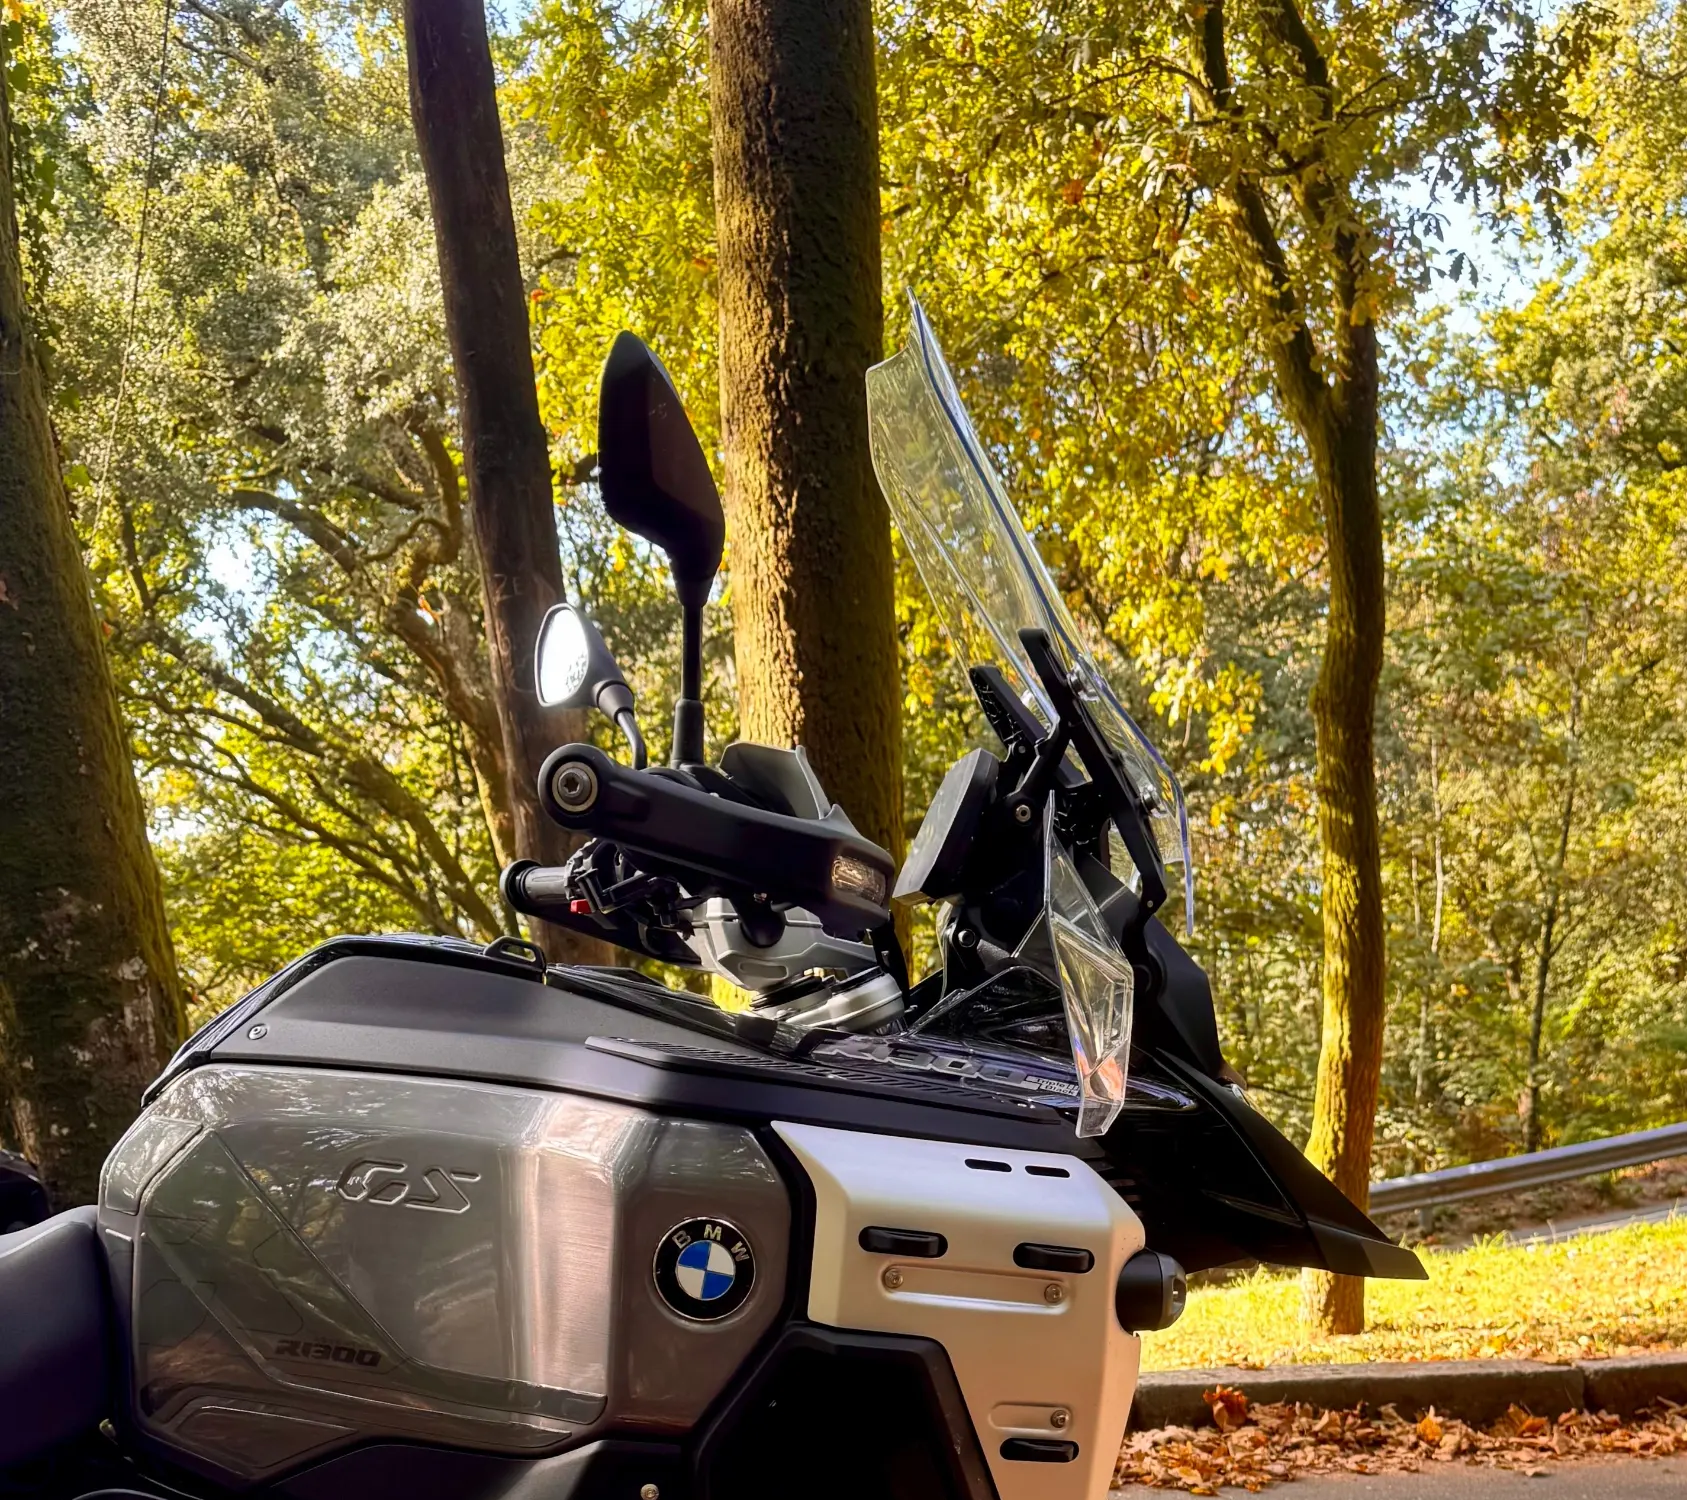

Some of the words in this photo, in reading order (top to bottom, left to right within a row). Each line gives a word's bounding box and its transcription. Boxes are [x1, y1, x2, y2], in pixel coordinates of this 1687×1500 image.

[336, 1158, 481, 1214] GS
[672, 1224, 750, 1262] BMW
[275, 1340, 381, 1367] R1300
